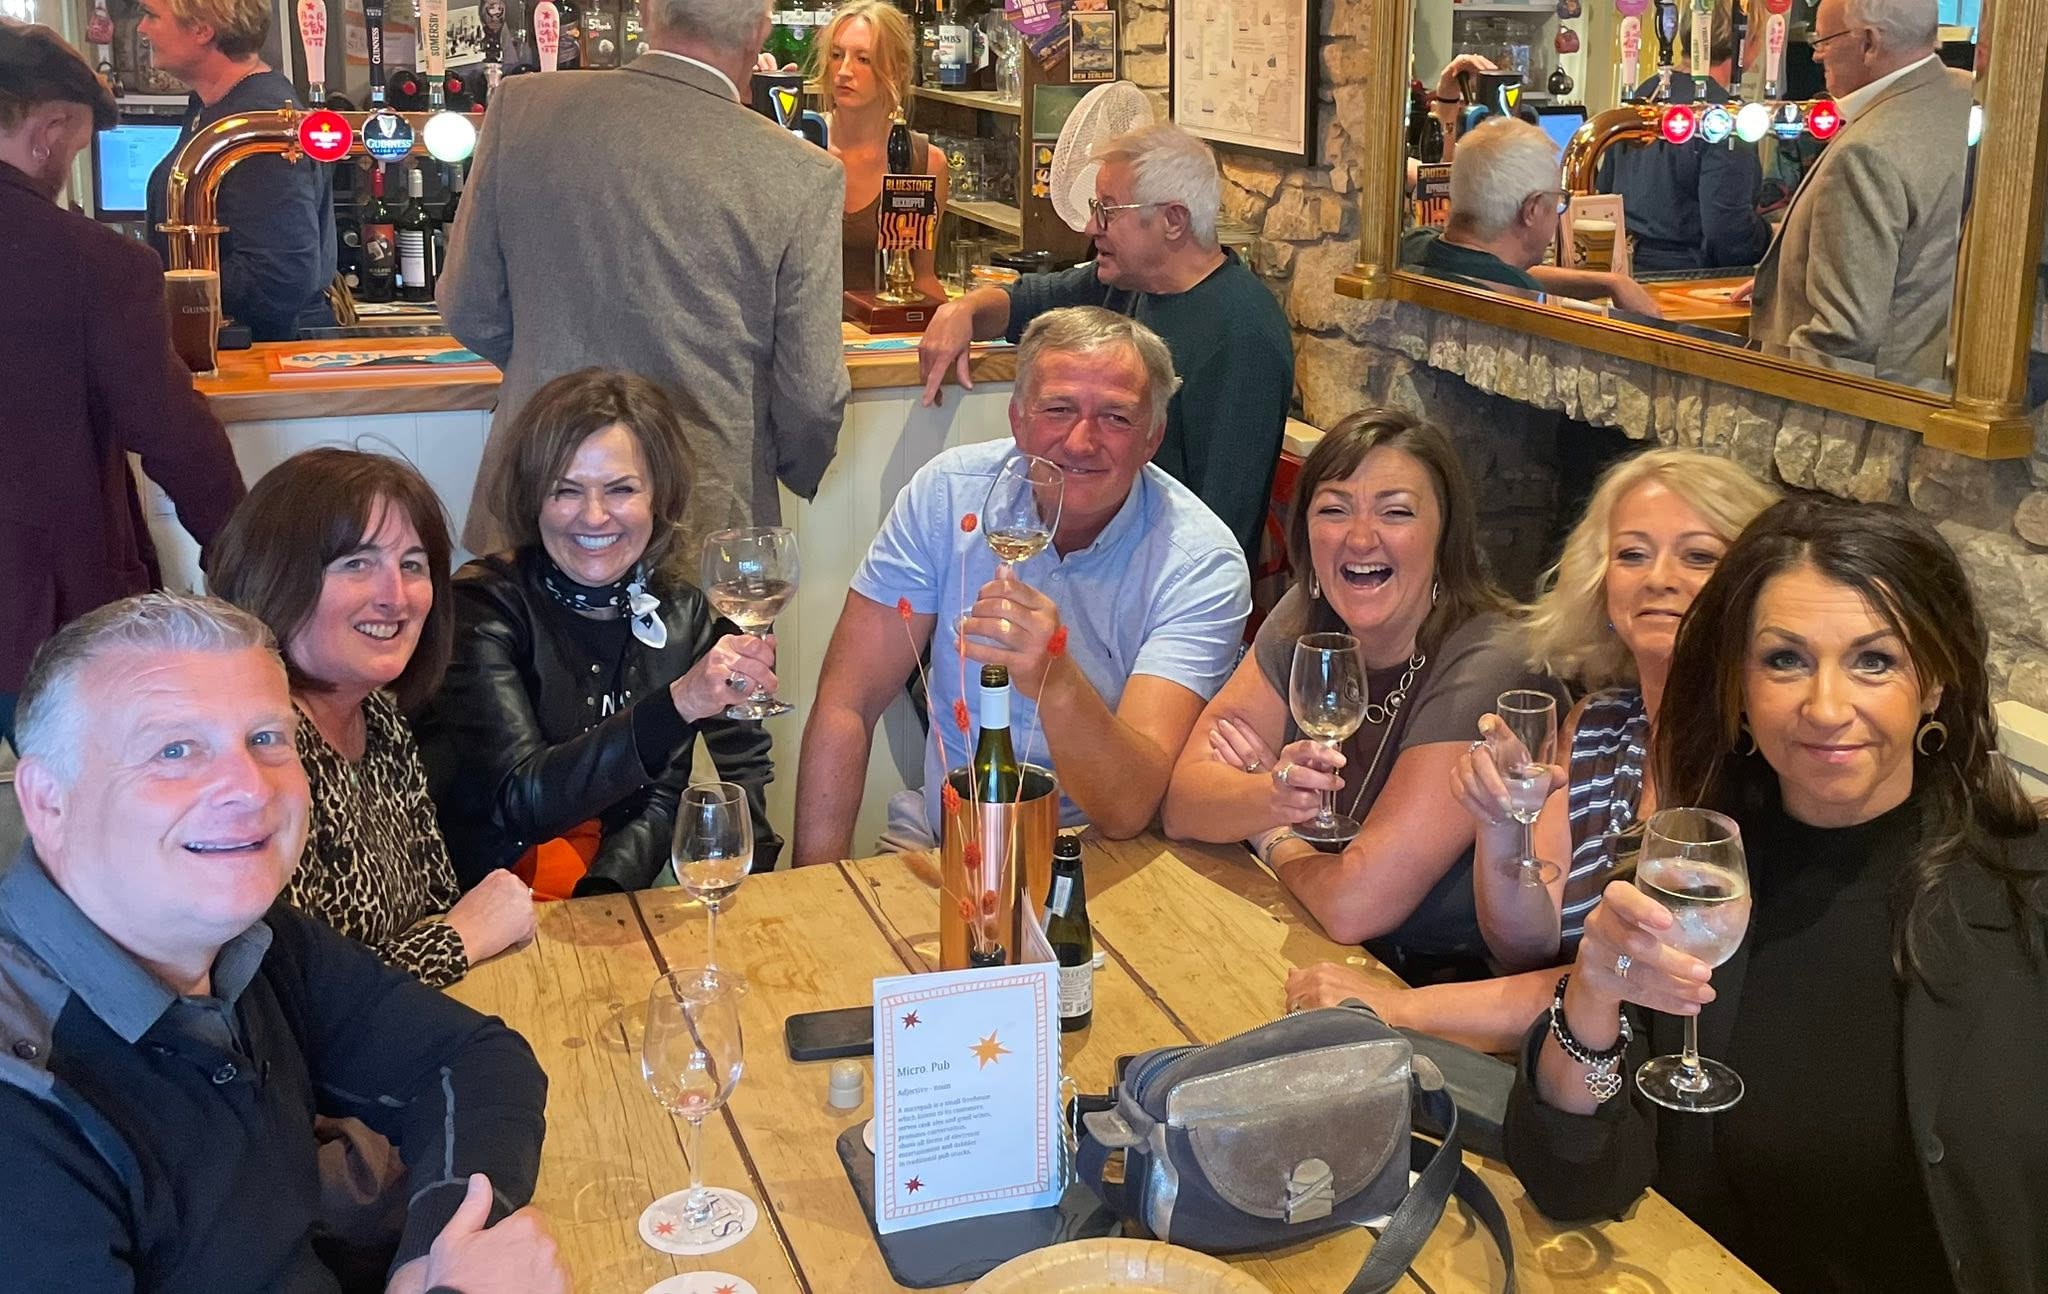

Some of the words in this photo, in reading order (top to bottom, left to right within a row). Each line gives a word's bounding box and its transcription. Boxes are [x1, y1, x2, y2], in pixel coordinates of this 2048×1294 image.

[372, 27, 381, 65] GUINNESS
[366, 139, 413, 149] GUINNESS
[886, 179, 933, 192] BLUESTONE
[897, 1065, 926, 1077] Micro
[931, 1060, 950, 1072] Pub
[897, 1087, 928, 1097] Adjective
[933, 1083, 951, 1091] noun
